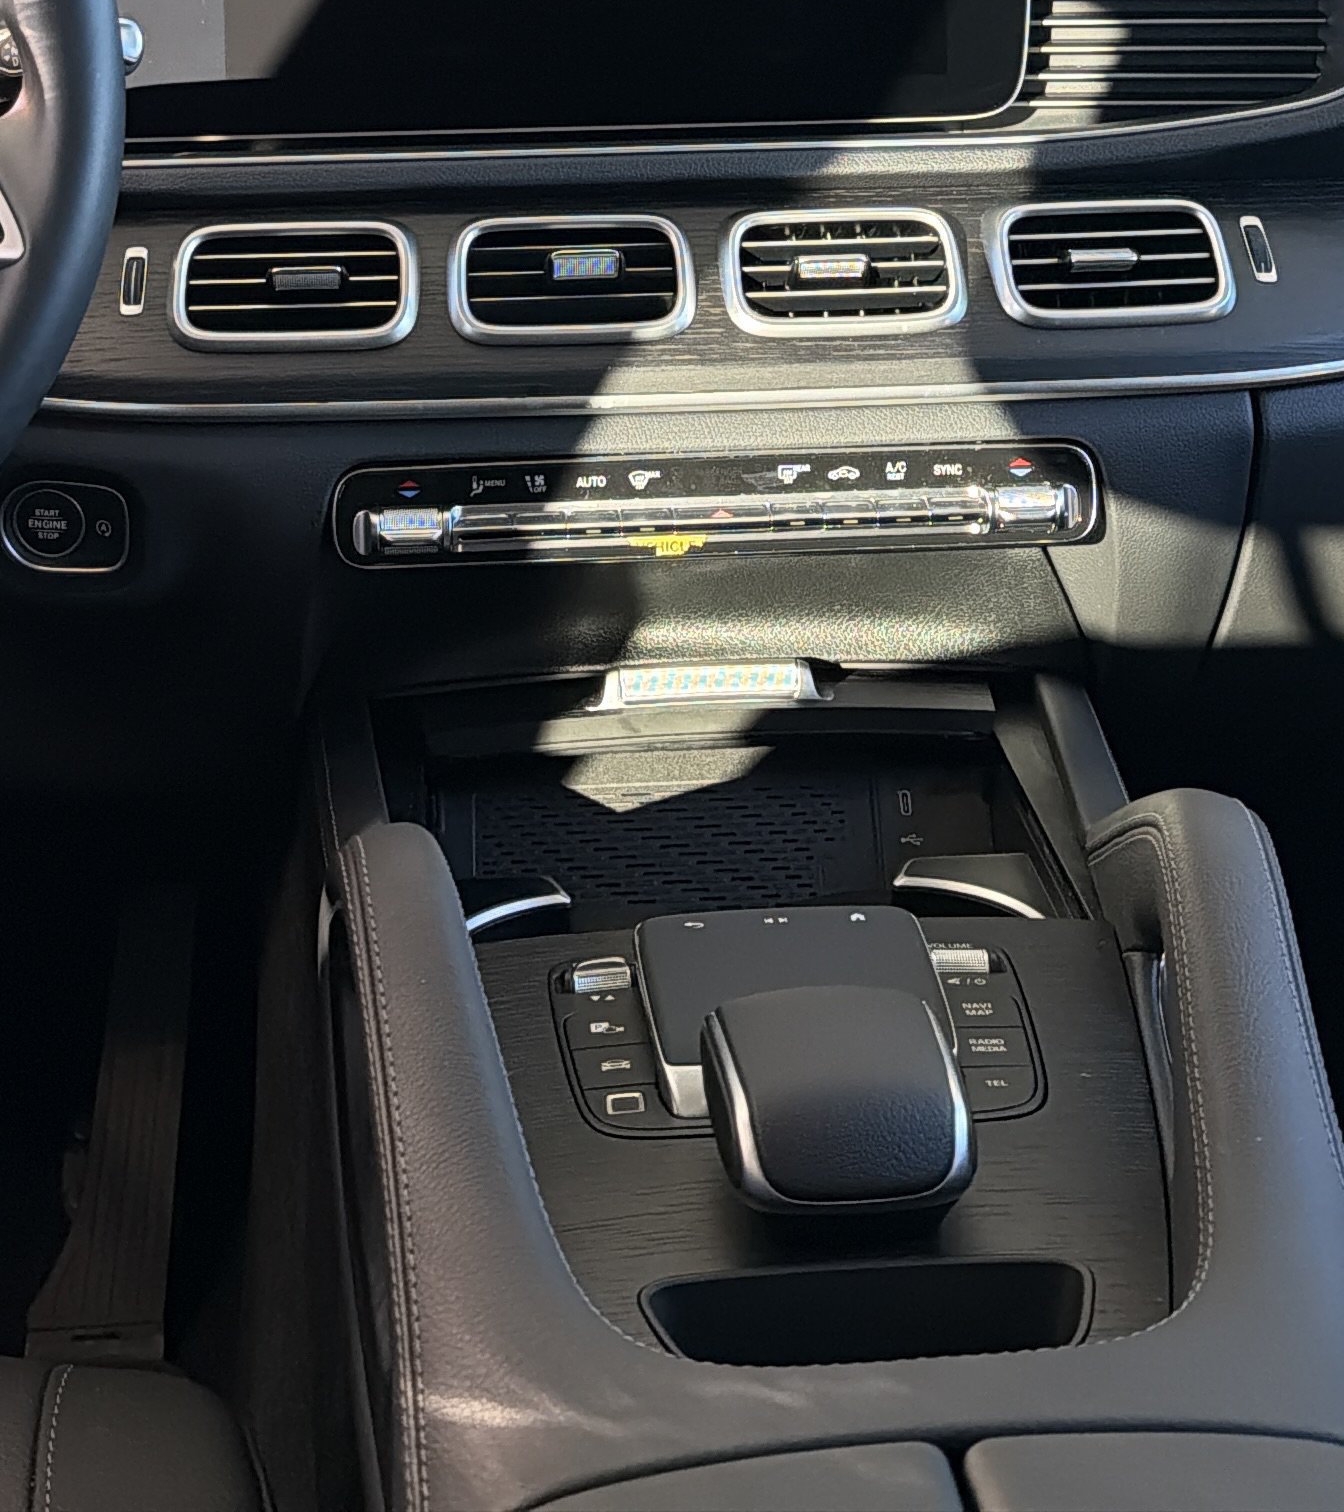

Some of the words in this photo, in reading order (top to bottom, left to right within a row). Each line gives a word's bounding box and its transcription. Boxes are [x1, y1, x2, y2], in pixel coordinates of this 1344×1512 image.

[885, 461, 907, 473] A/C
[933, 463, 963, 476] SYNC
[485, 478, 506, 487] MENU
[576, 475, 607, 488] AUTO
[534, 485, 548, 494] OFF
[35, 509, 60, 517] START
[28, 519, 68, 530] ENGINE
[38, 531, 60, 540] STOP
[927, 942, 974, 950] VOLUME
